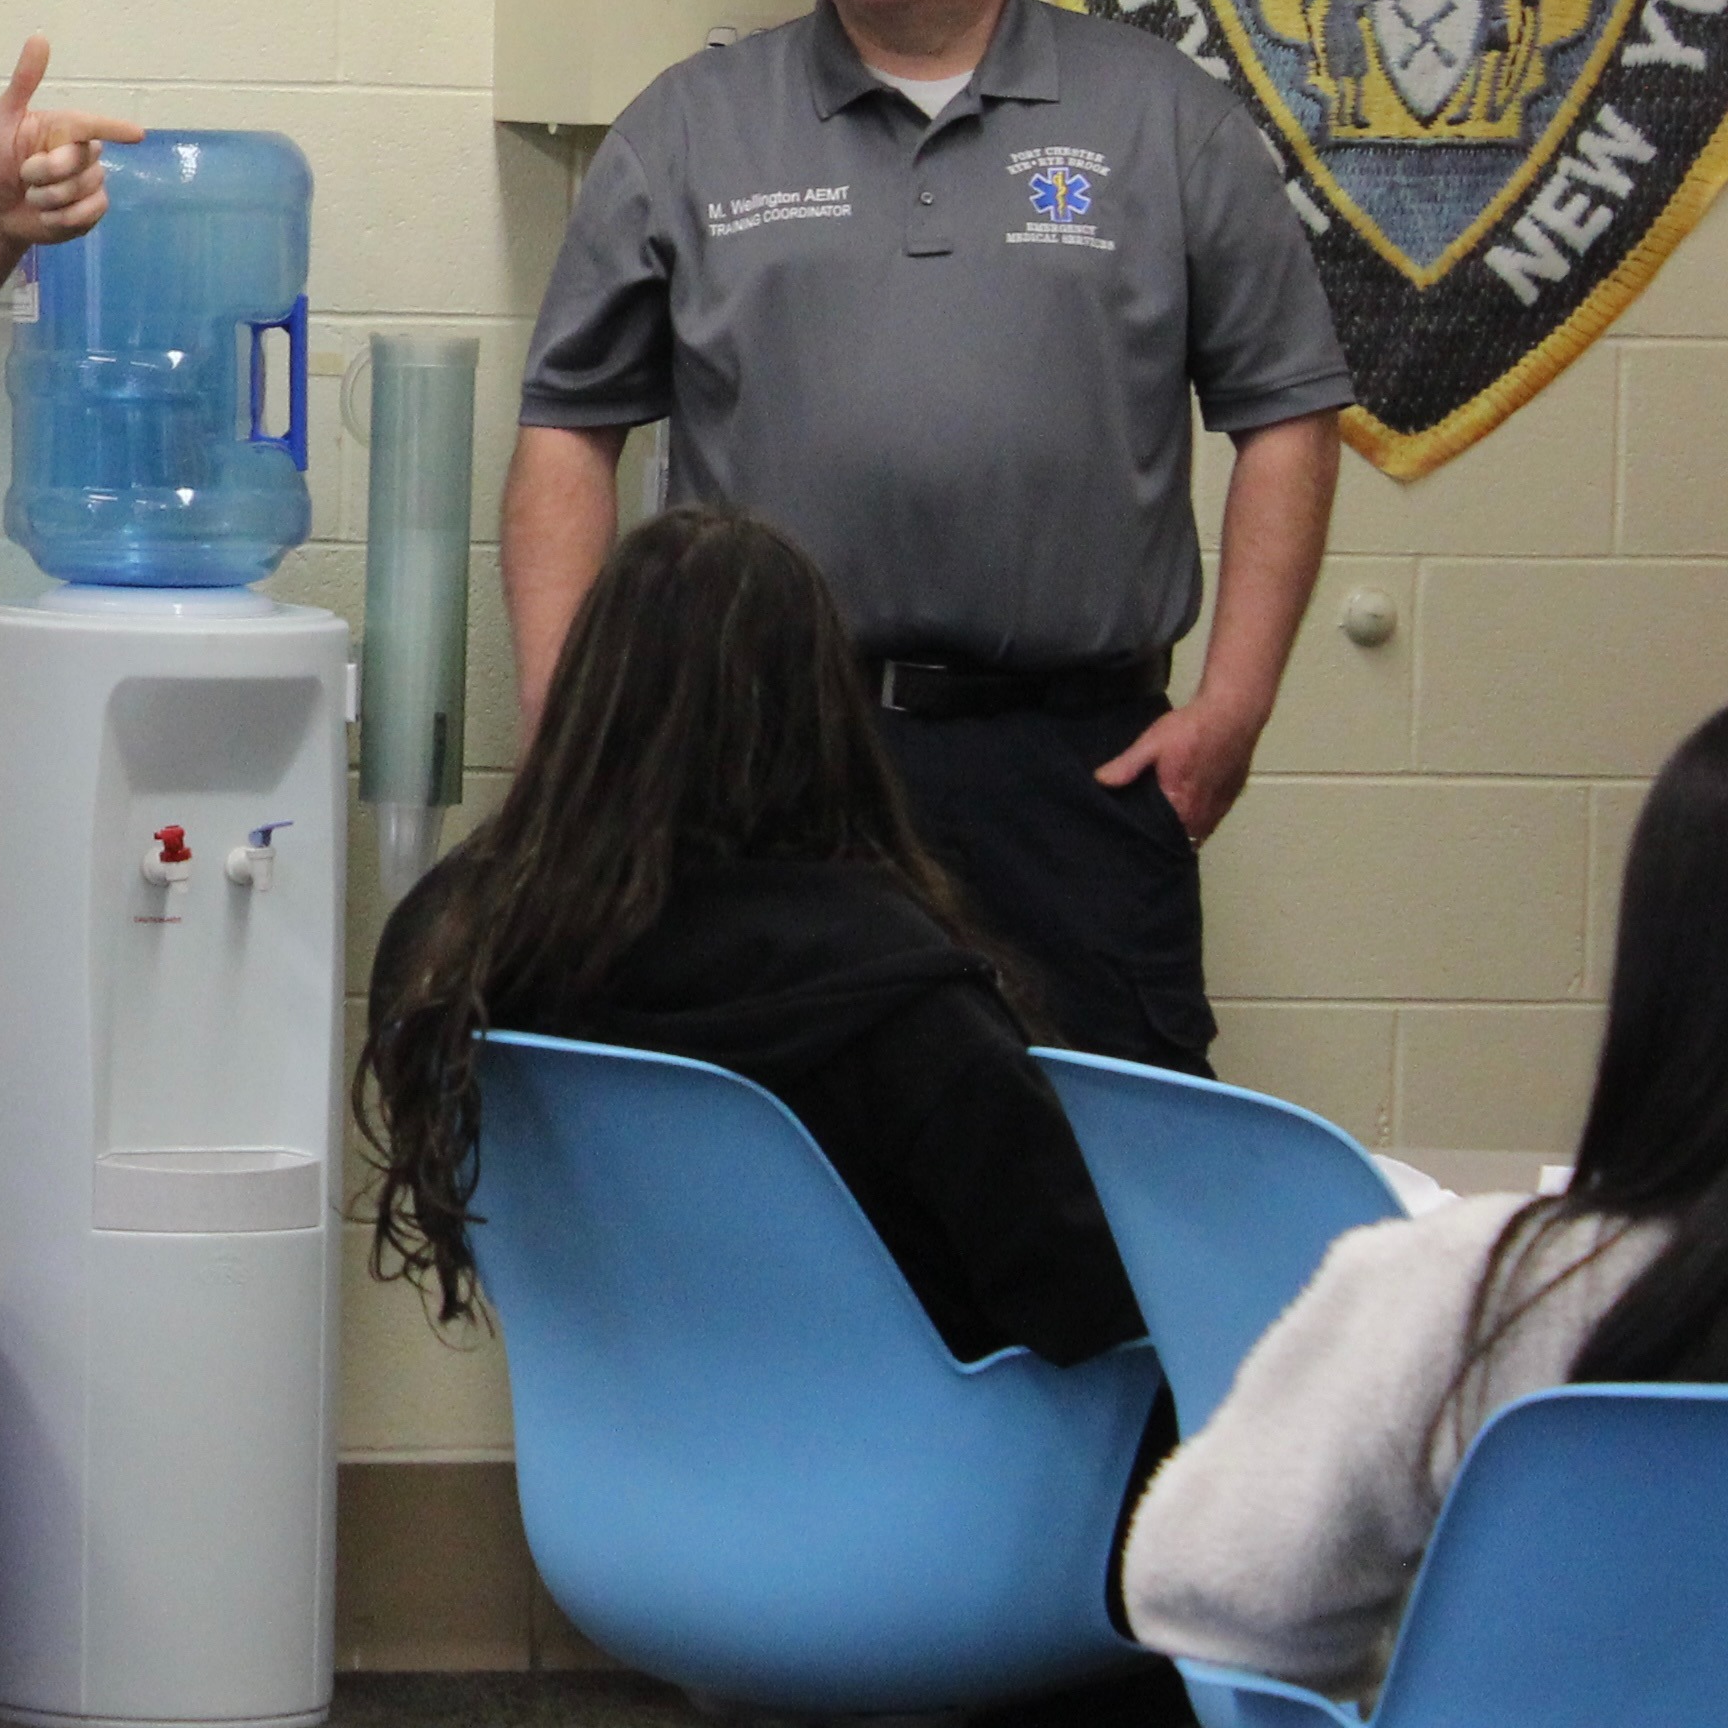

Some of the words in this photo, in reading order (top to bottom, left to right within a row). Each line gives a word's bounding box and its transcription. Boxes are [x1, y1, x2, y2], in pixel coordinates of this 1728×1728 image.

[708, 203, 727, 220] M.
[730, 190, 801, 216] Wellington
[804, 185, 850, 202] AEMT
[709, 213, 761, 236] TRAINING
[763, 204, 852, 223] COORDINATOR
[1485, 103, 1657, 306] NEW
